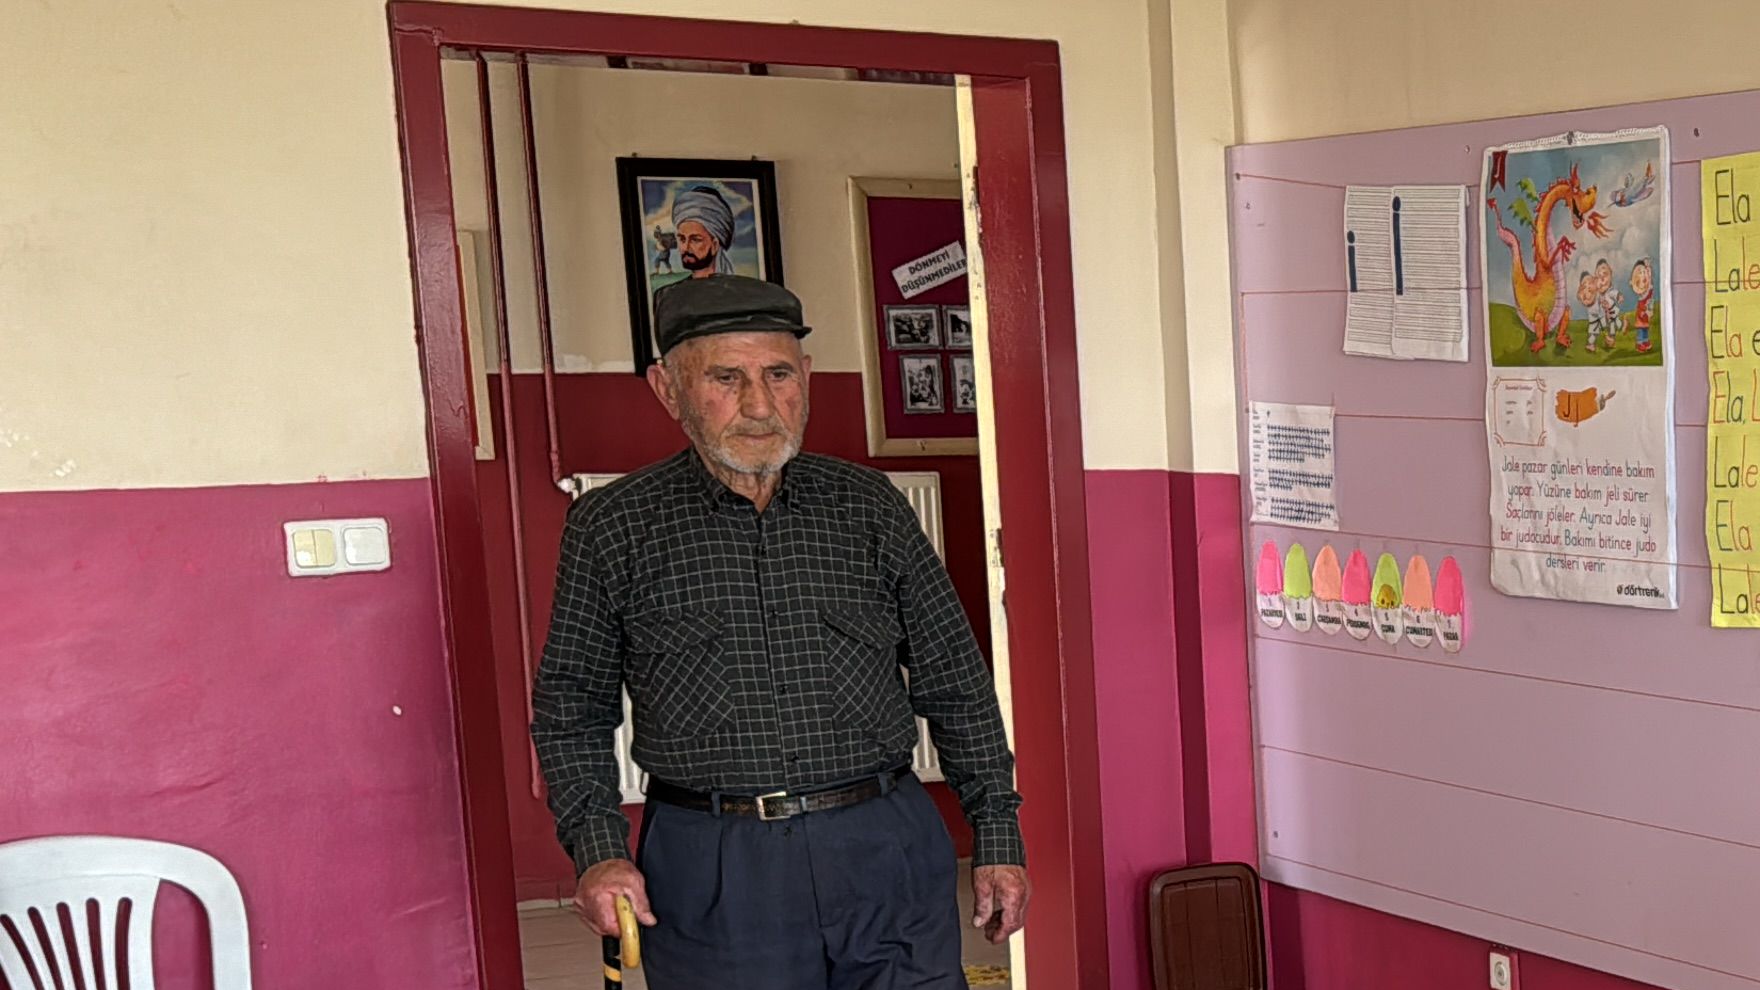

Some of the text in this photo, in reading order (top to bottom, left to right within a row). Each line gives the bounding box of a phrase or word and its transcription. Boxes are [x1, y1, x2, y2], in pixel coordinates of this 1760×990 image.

[1714, 167, 1750, 225] Ela
[908, 249, 949, 275] DÖNMEYİ
[1714, 236, 1760, 293] Lale
[1711, 304, 1743, 359] Ela
[1502, 455, 1655, 480] Jale pazar günleri kendine bakım
[1714, 434, 1758, 488] Lale
[1537, 479, 1571, 498] Yüzüne
[1574, 482, 1601, 500] bakım
[1605, 484, 1620, 507] jeli
[1579, 506, 1612, 530] Ayrıca
[1615, 509, 1636, 527] Jale
[1640, 512, 1651, 534] iyi
[1715, 499, 1752, 551] Ela
[1500, 526, 1513, 541] bir
[1564, 529, 1595, 547] Bakımı
[1599, 531, 1631, 550] bitince
[1634, 537, 1656, 557] judo
[1546, 553, 1579, 570] dersleri
